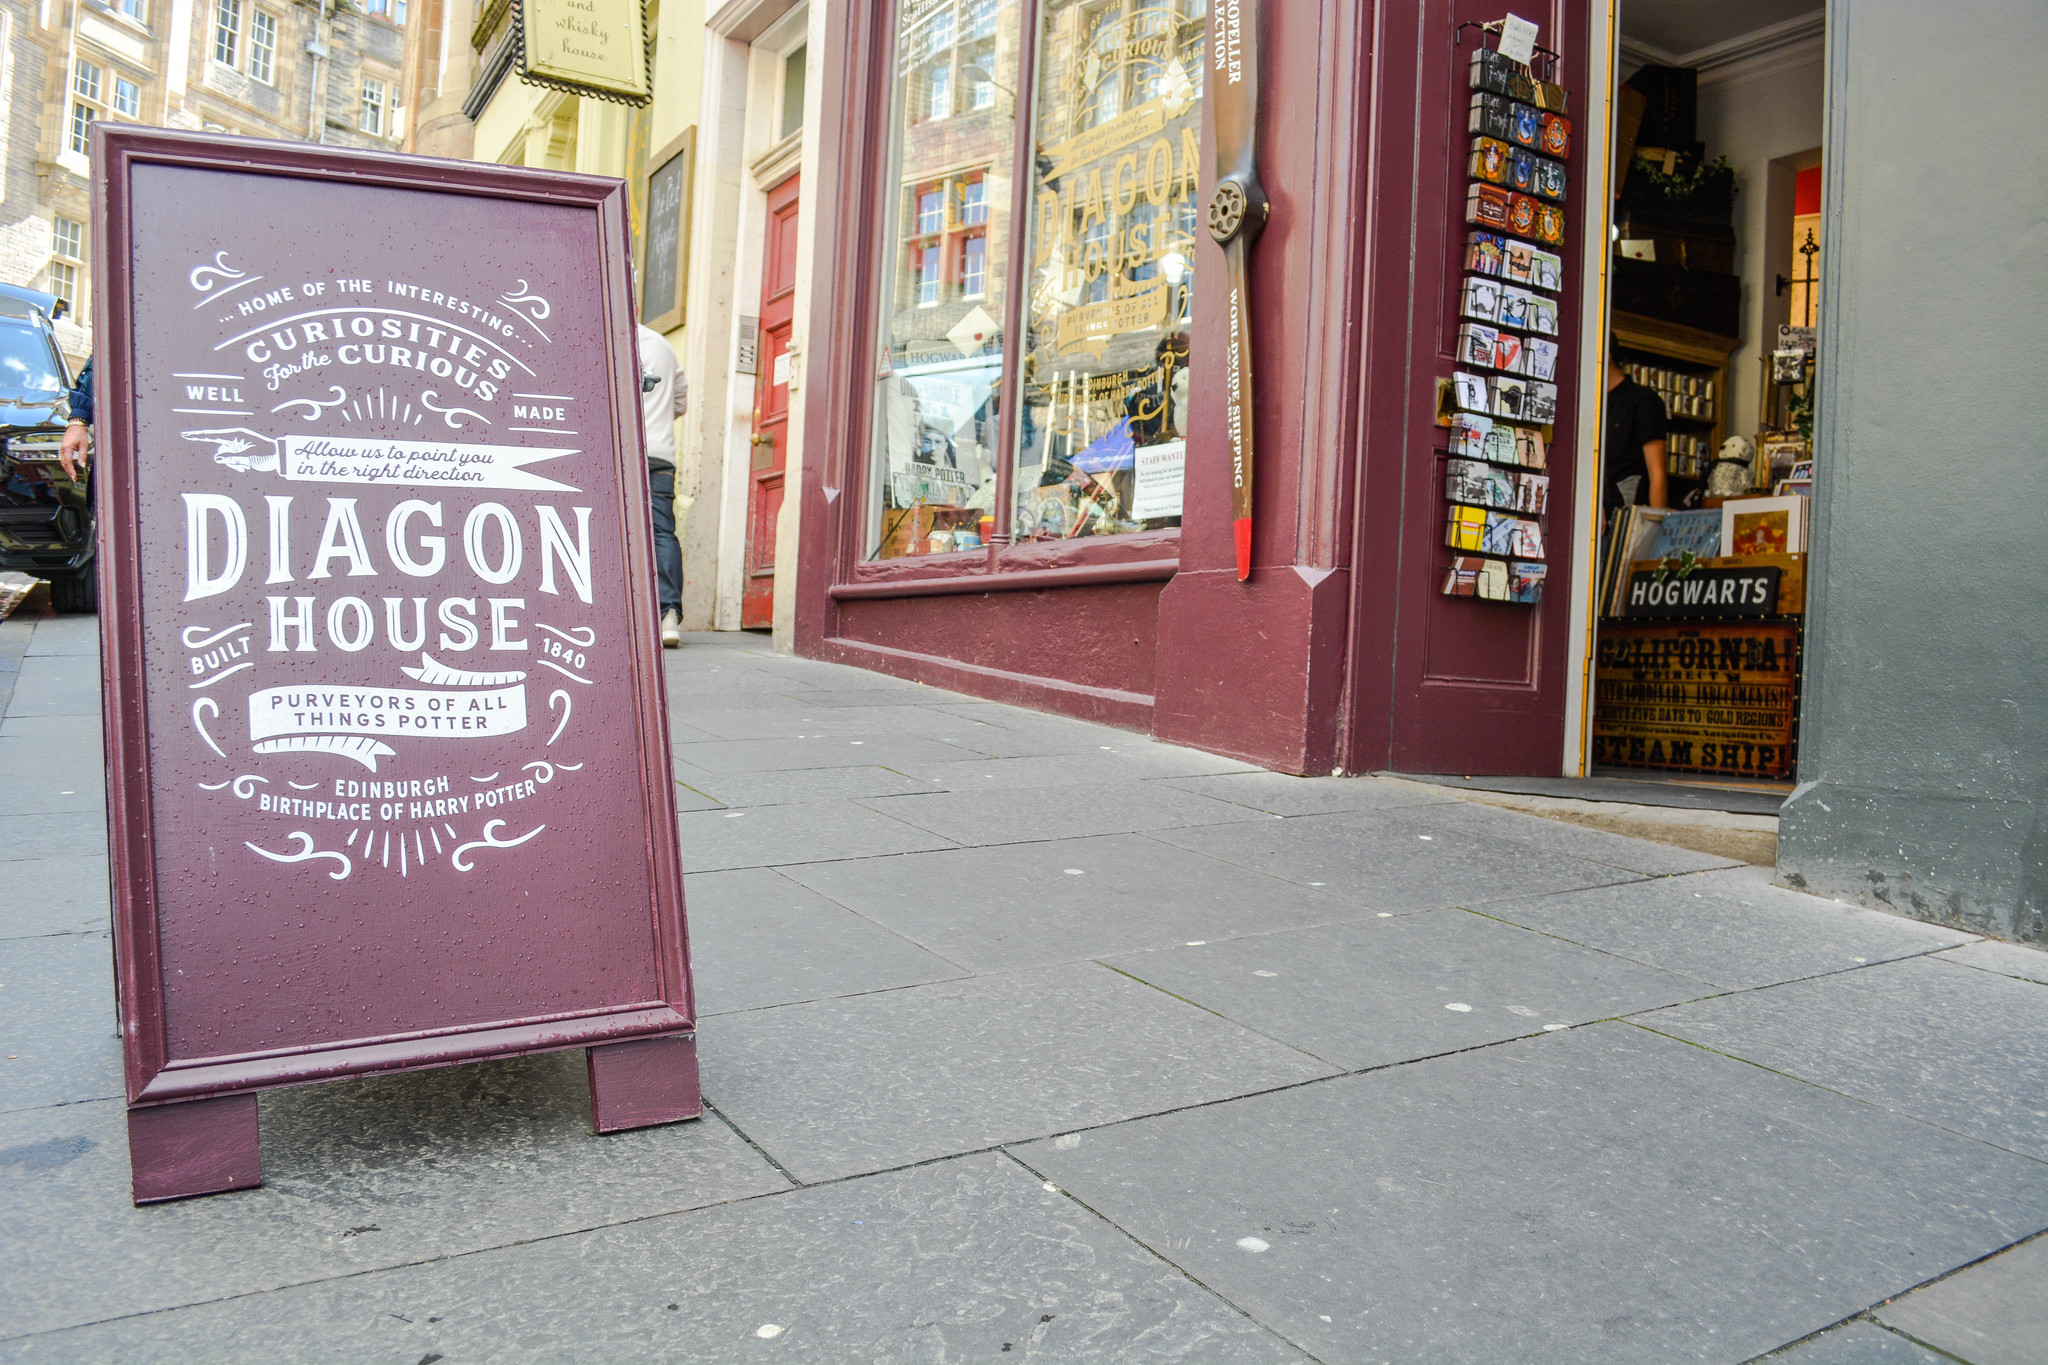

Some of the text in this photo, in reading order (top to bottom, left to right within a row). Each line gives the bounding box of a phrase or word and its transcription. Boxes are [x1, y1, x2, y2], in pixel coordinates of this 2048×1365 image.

[567, 1, 595, 12] and
[555, 16, 610, 45] whisky
[1214, 0, 1226, 71] LECTION
[1227, 0, 1242, 85] ROPELLER
[562, 38, 608, 62] house
[1101, 38, 1173, 72] CURIOUS
[1035, 127, 1200, 269] DIAGON
[1062, 213, 1172, 293] HOUSE
[302, 280, 326, 297] OF
[336, 278, 372, 293] THE
[1067, 294, 1159, 327] PURVEYORS OF ALL
[245, 316, 512, 380] CURIOSITIES
[262, 344, 499, 402] For the CURIOUS
[186, 385, 245, 403] WELL
[1098, 392, 1109, 402] OF
[1229, 287, 1243, 489] WORLDWIDE SHIPPING
[513, 404, 566, 421] MADE
[294, 439, 495, 468] Allow us to point you
[1161, 450, 1184, 463] WANTE
[297, 460, 486, 484] in the right direction
[935, 465, 966, 483] POTTER
[181, 492, 593, 605] DIAGON
[1630, 576, 1769, 606] HOGWARTS
[265, 595, 529, 654] HOUSE
[190, 636, 252, 677] BUILT
[542, 637, 587, 670] 1840
[1653, 670, 1719, 681] DIRECT
[271, 693, 508, 712] PURVEYORS OF ALL
[1595, 704, 1789, 728] THIRTY-FIVE DAYS TO GOLD REGIONS!
[294, 712, 488, 730] THINGS POTTER
[1671, 727, 1701, 736] Steam
[1703, 729, 1757, 741] Navigation
[1592, 735, 1787, 772] STEAM SHIP!
[260, 779, 538, 821] BIRTHPLACE OF HARRY POTTER
[335, 775, 451, 798] EDINBURGH
